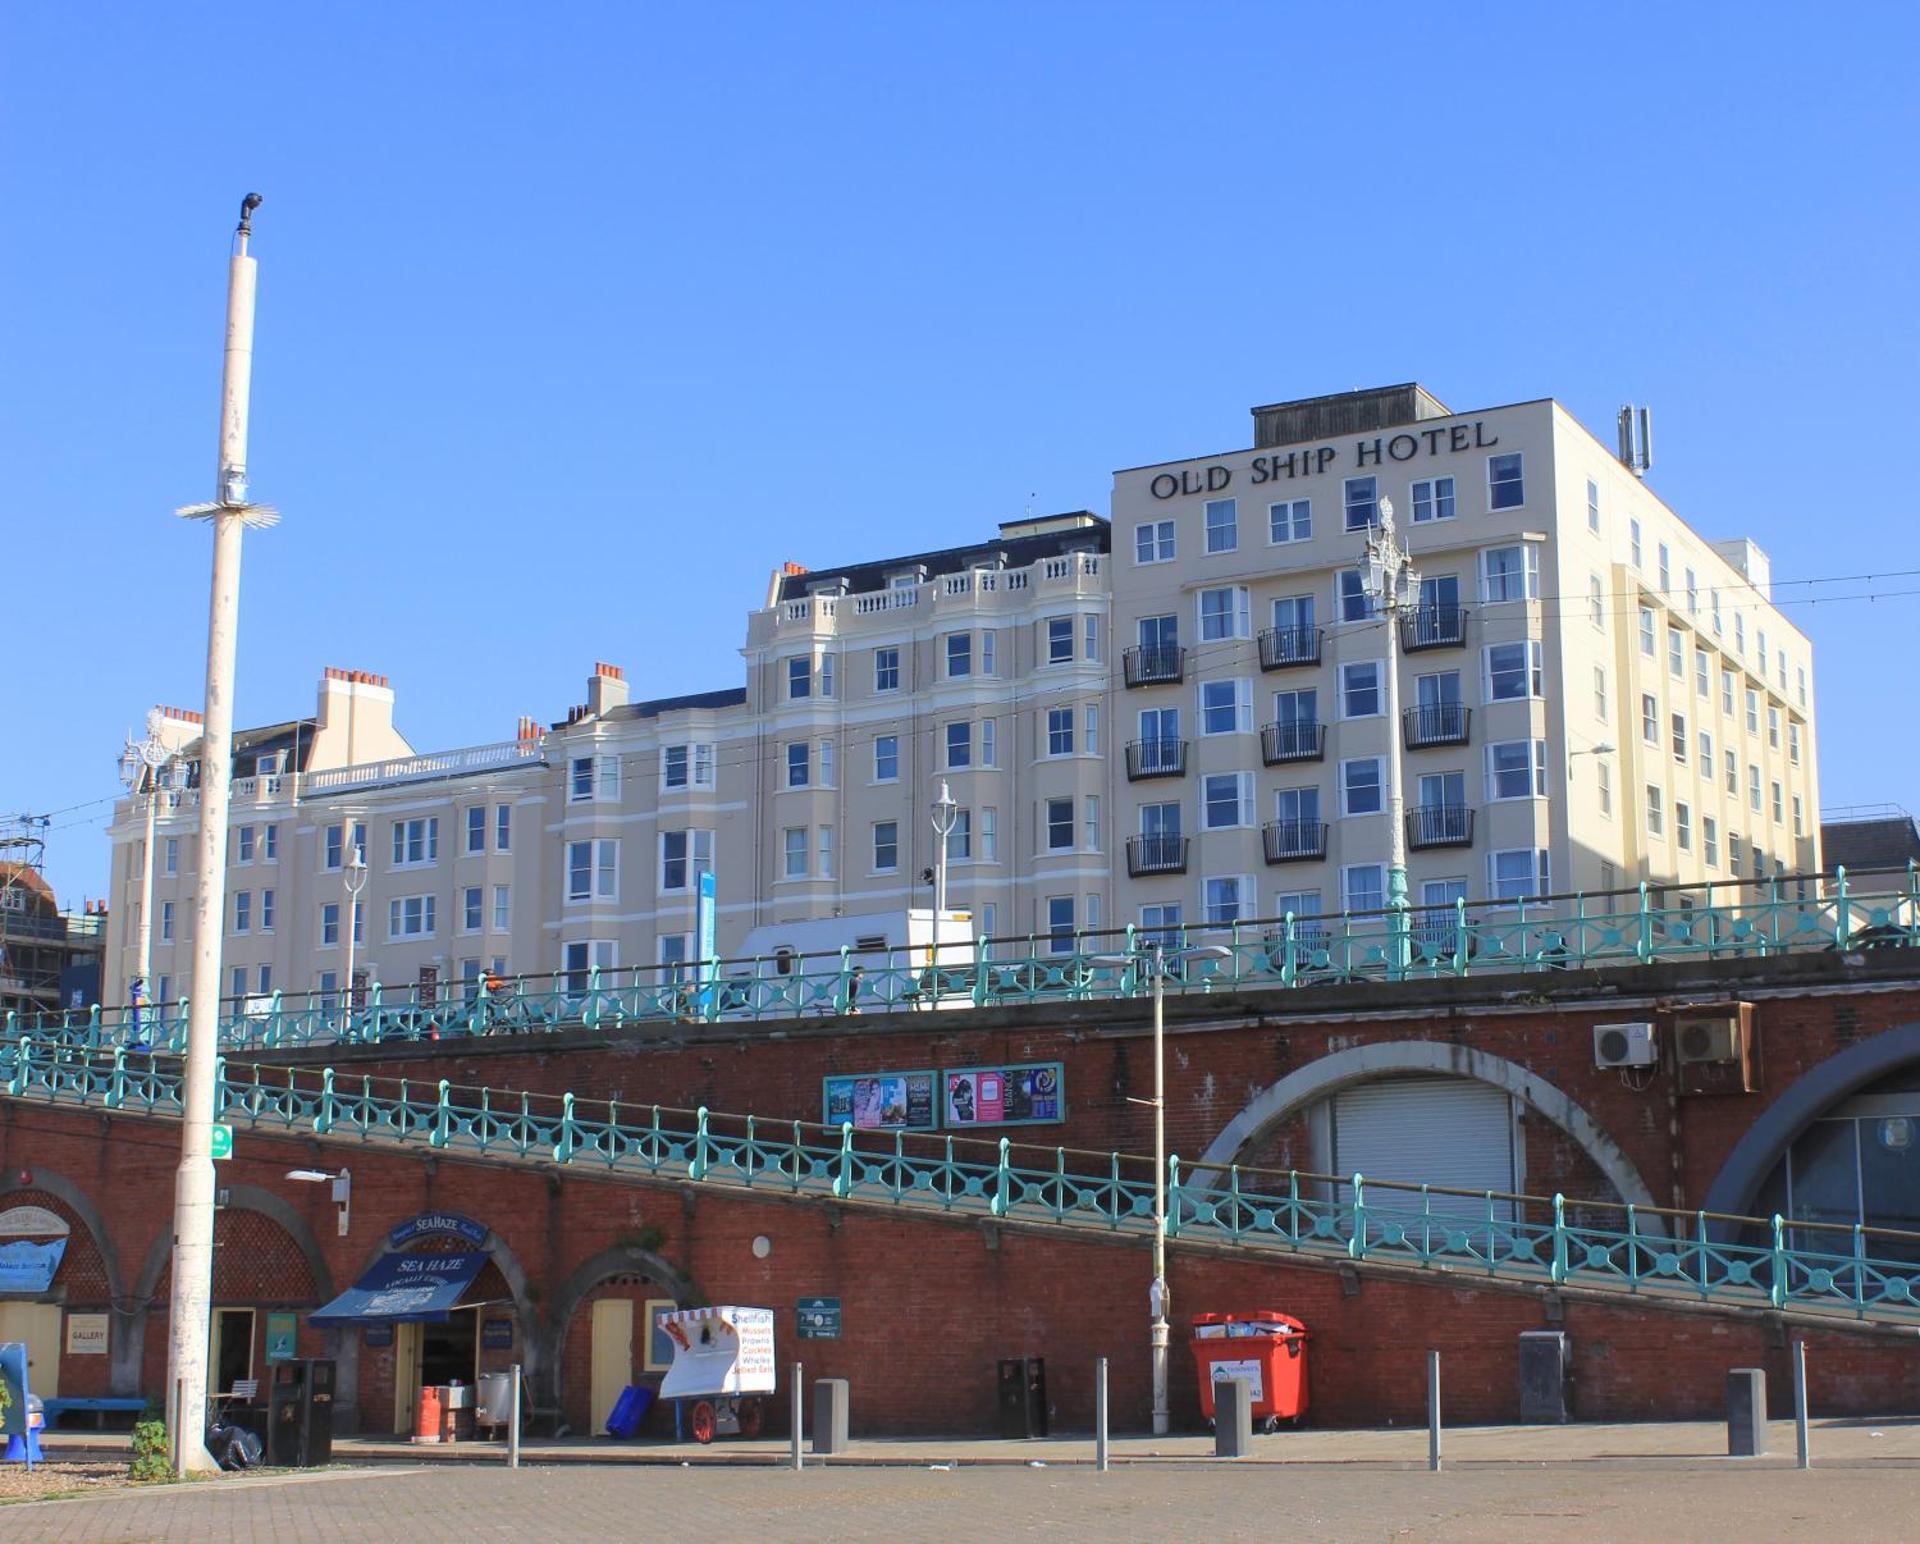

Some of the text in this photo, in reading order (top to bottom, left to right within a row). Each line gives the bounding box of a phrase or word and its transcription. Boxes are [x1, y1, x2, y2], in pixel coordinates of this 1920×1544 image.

[1150, 422, 1498, 500] OLD SHIP HOTEL
[397, 1258, 465, 1272] SEA HAZE
[731, 1311, 771, 1324] Shellfish
